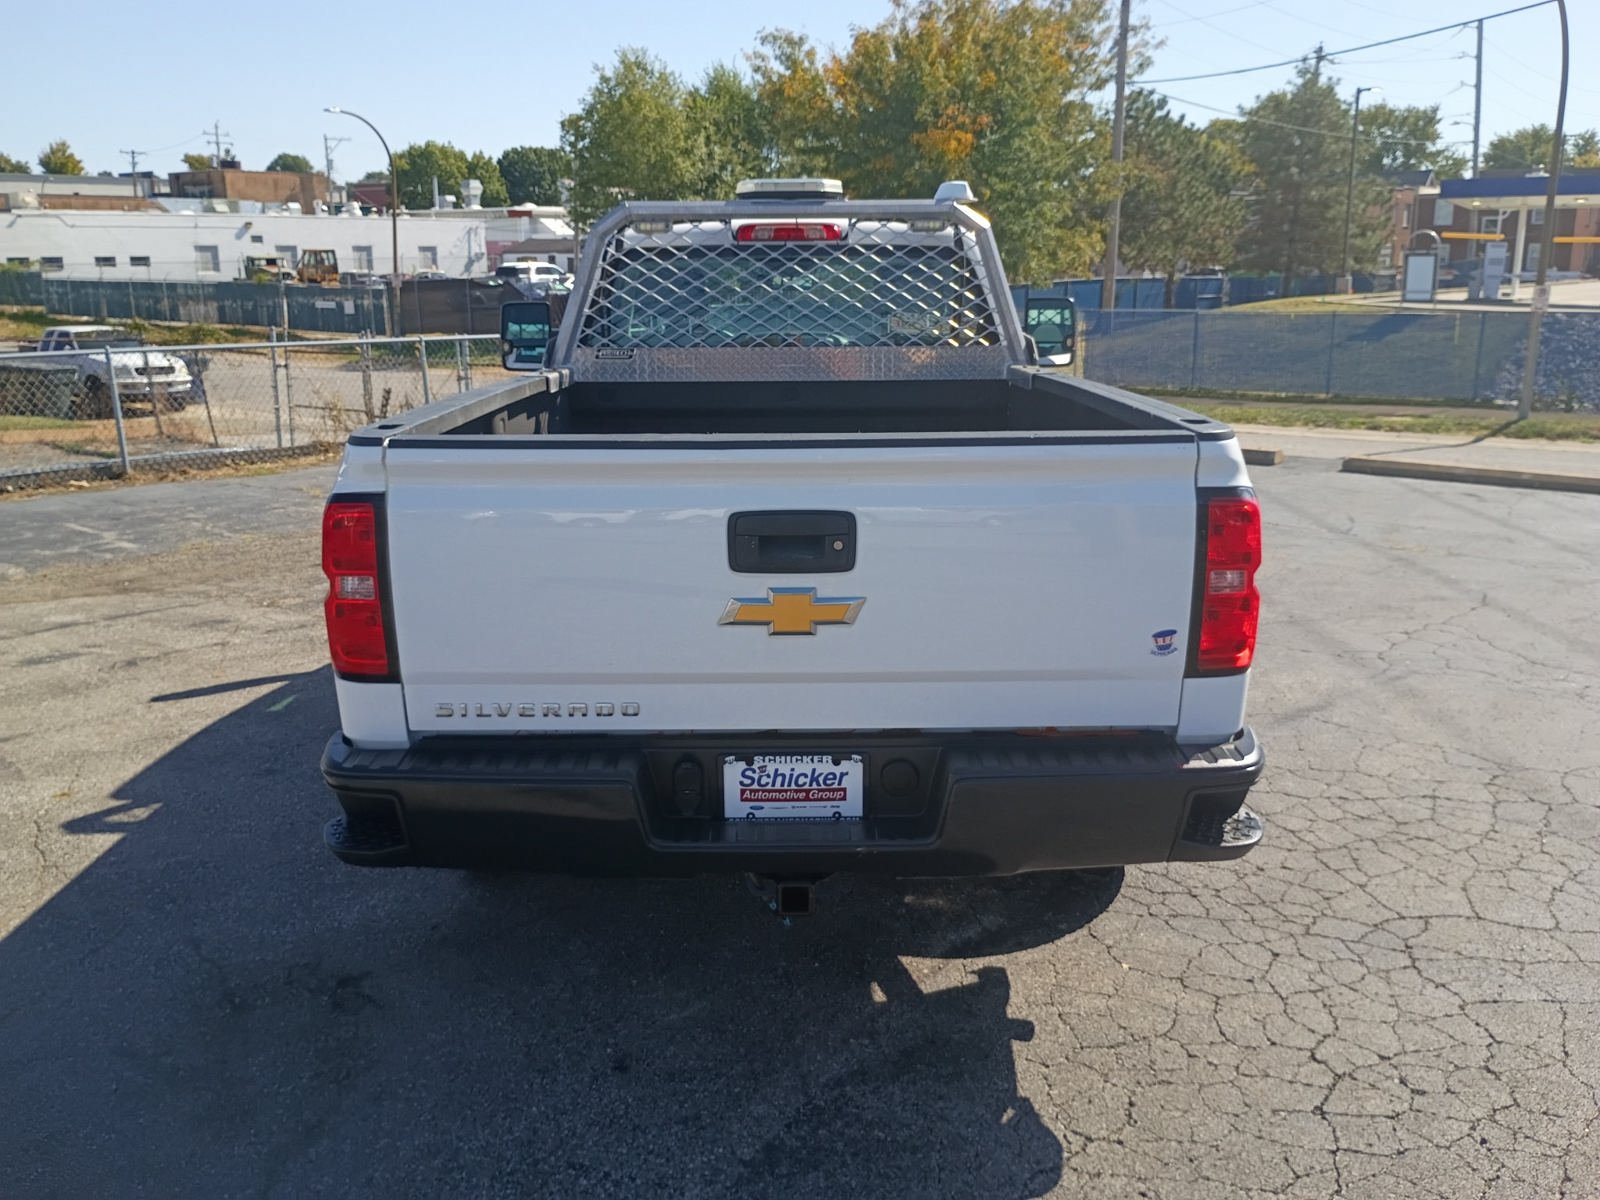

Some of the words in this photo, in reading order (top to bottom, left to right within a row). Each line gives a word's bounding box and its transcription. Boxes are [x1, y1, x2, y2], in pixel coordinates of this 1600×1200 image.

[434, 702, 641, 718] SILVERADO
[753, 755, 833, 764] SCHICKER
[739, 766, 849, 788] Schicker
[742, 789, 806, 800] Automotive
[808, 789, 845, 801] Group
